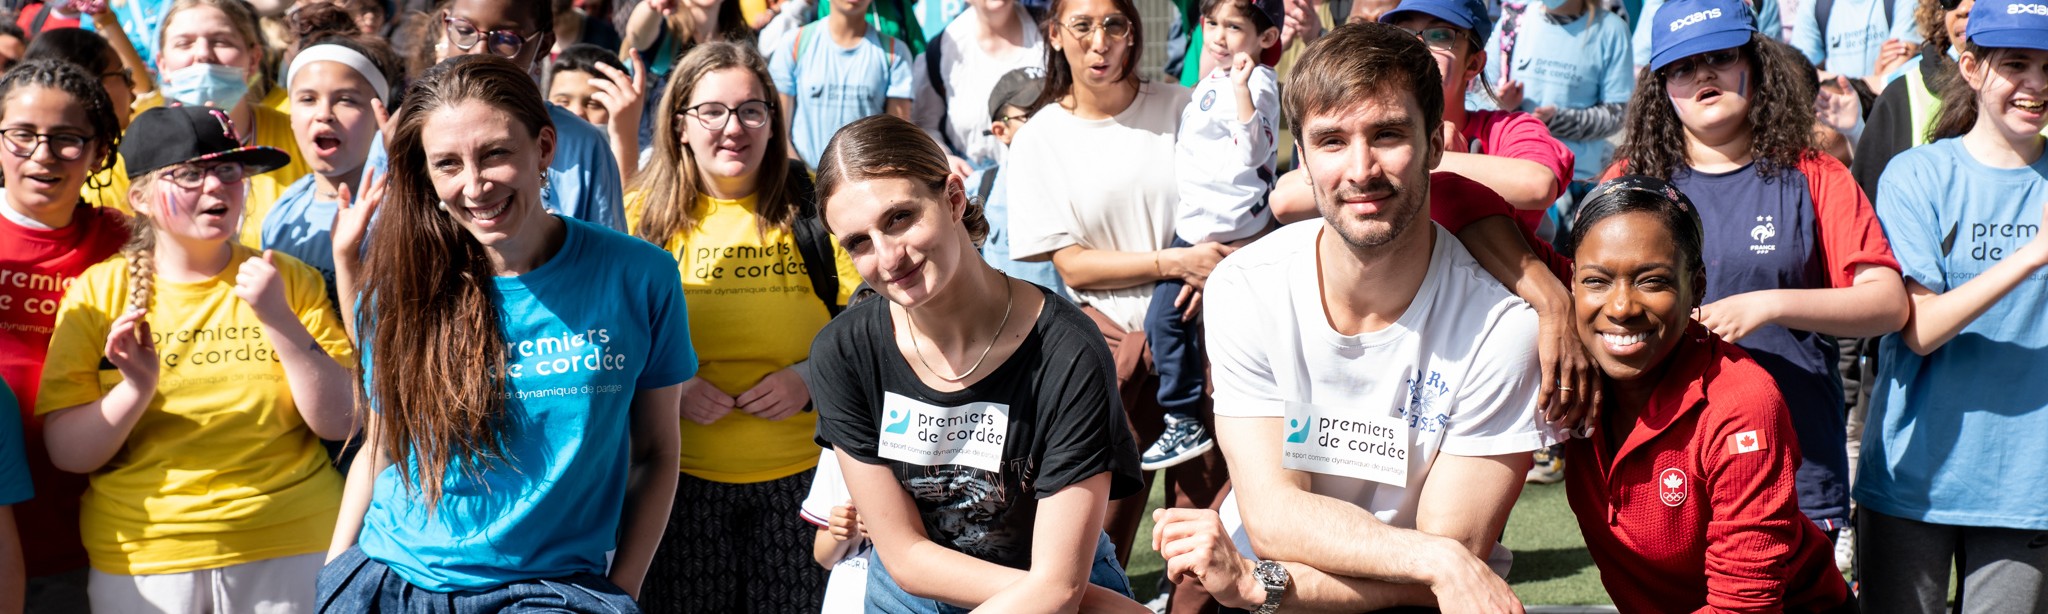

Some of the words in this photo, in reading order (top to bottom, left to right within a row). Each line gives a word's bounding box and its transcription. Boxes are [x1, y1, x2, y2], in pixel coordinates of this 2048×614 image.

[1670, 8, 1721, 32] axians
[697, 242, 790, 264] premiers
[1971, 241, 2003, 261] de
[696, 263, 724, 279] de
[714, 286, 767, 296] dynamique
[769, 285, 781, 293] de
[24, 298, 56, 315] co
[535, 346, 626, 376] cordée
[514, 386, 577, 401] dynamique
[580, 384, 594, 394] de
[596, 384, 622, 395] partage
[918, 411, 994, 428] premiers
[1319, 416, 1395, 440] premiers
[917, 428, 939, 443] de
[946, 427, 1003, 445] cordée
[889, 441, 907, 450] sport
[907, 446, 931, 456] comme
[933, 447, 971, 458] dynamique
[1318, 432, 1340, 448] de
[1348, 438, 1405, 460] cordée
[1292, 451, 1307, 460] sport
[1307, 454, 1330, 463] comme
[1331, 457, 1370, 468] dynamique
[1371, 463, 1381, 471] de
